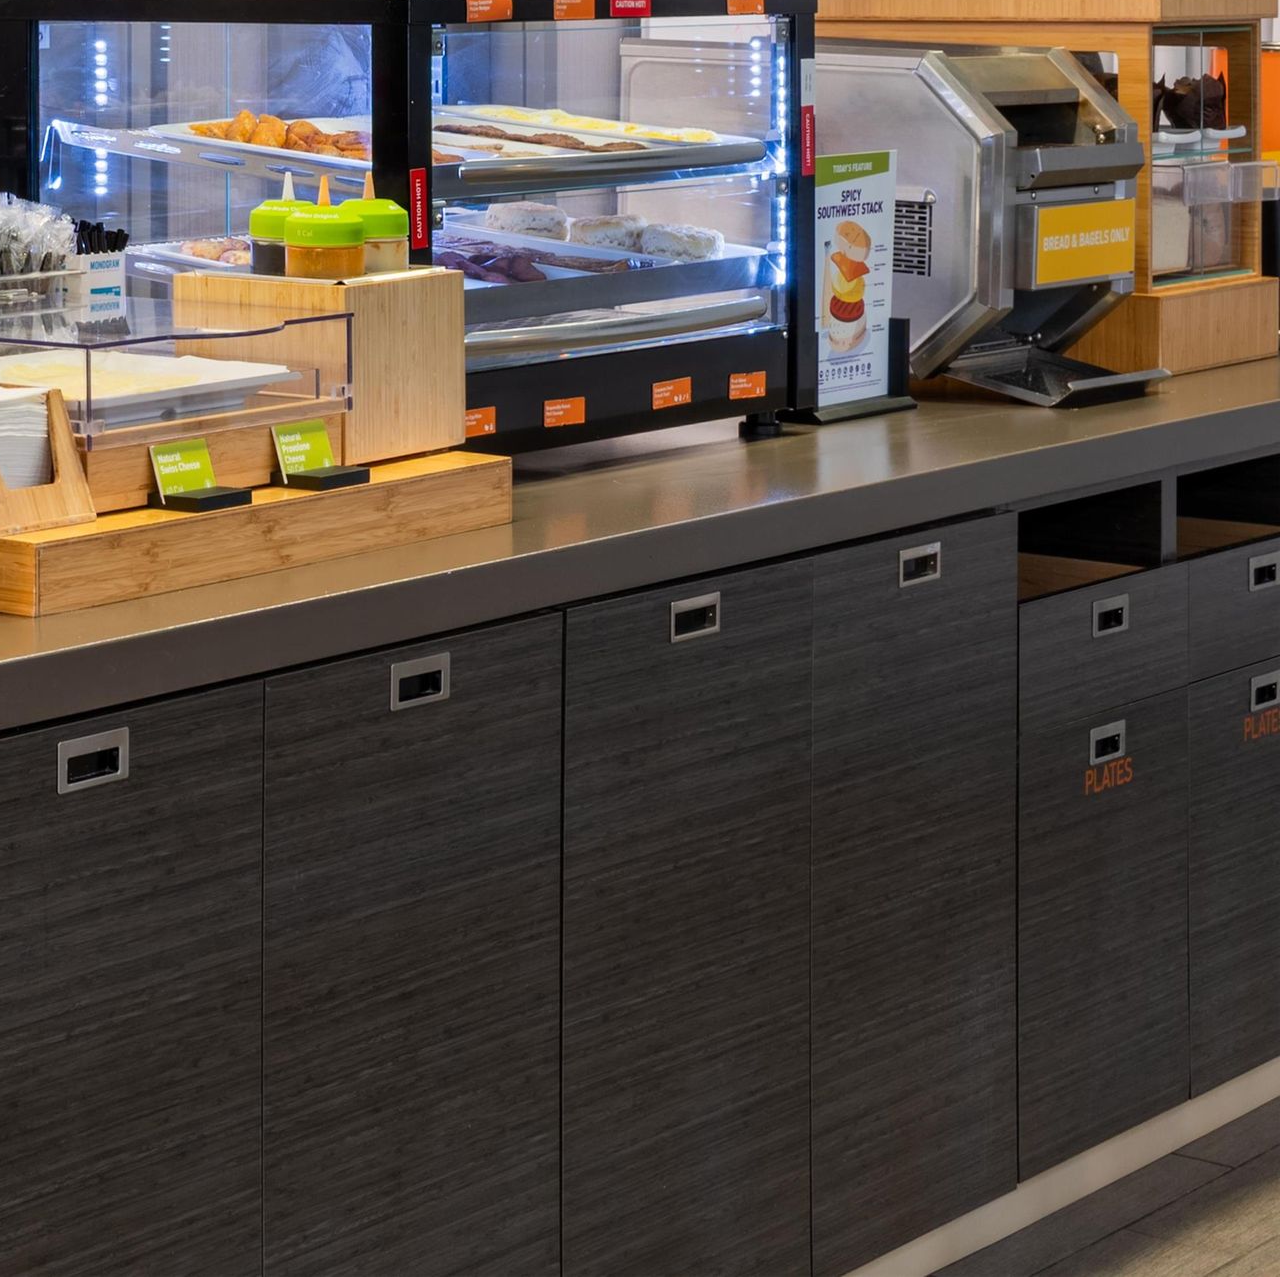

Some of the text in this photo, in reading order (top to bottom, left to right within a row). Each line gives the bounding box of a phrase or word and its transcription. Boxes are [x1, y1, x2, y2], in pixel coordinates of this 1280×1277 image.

[841, 188, 861, 202] SPICY
[817, 201, 883, 219] SOUTHWEST STACK
[1043, 226, 1130, 251] BREAD & BAGELS ONLY
[279, 432, 301, 443] Natural
[282, 441, 310, 453] Provolone
[157, 452, 181, 463] Natural
[284, 454, 305, 464] Cheese
[160, 461, 200, 474] Swiss Cheese
[1085, 756, 1134, 796] PLATES
